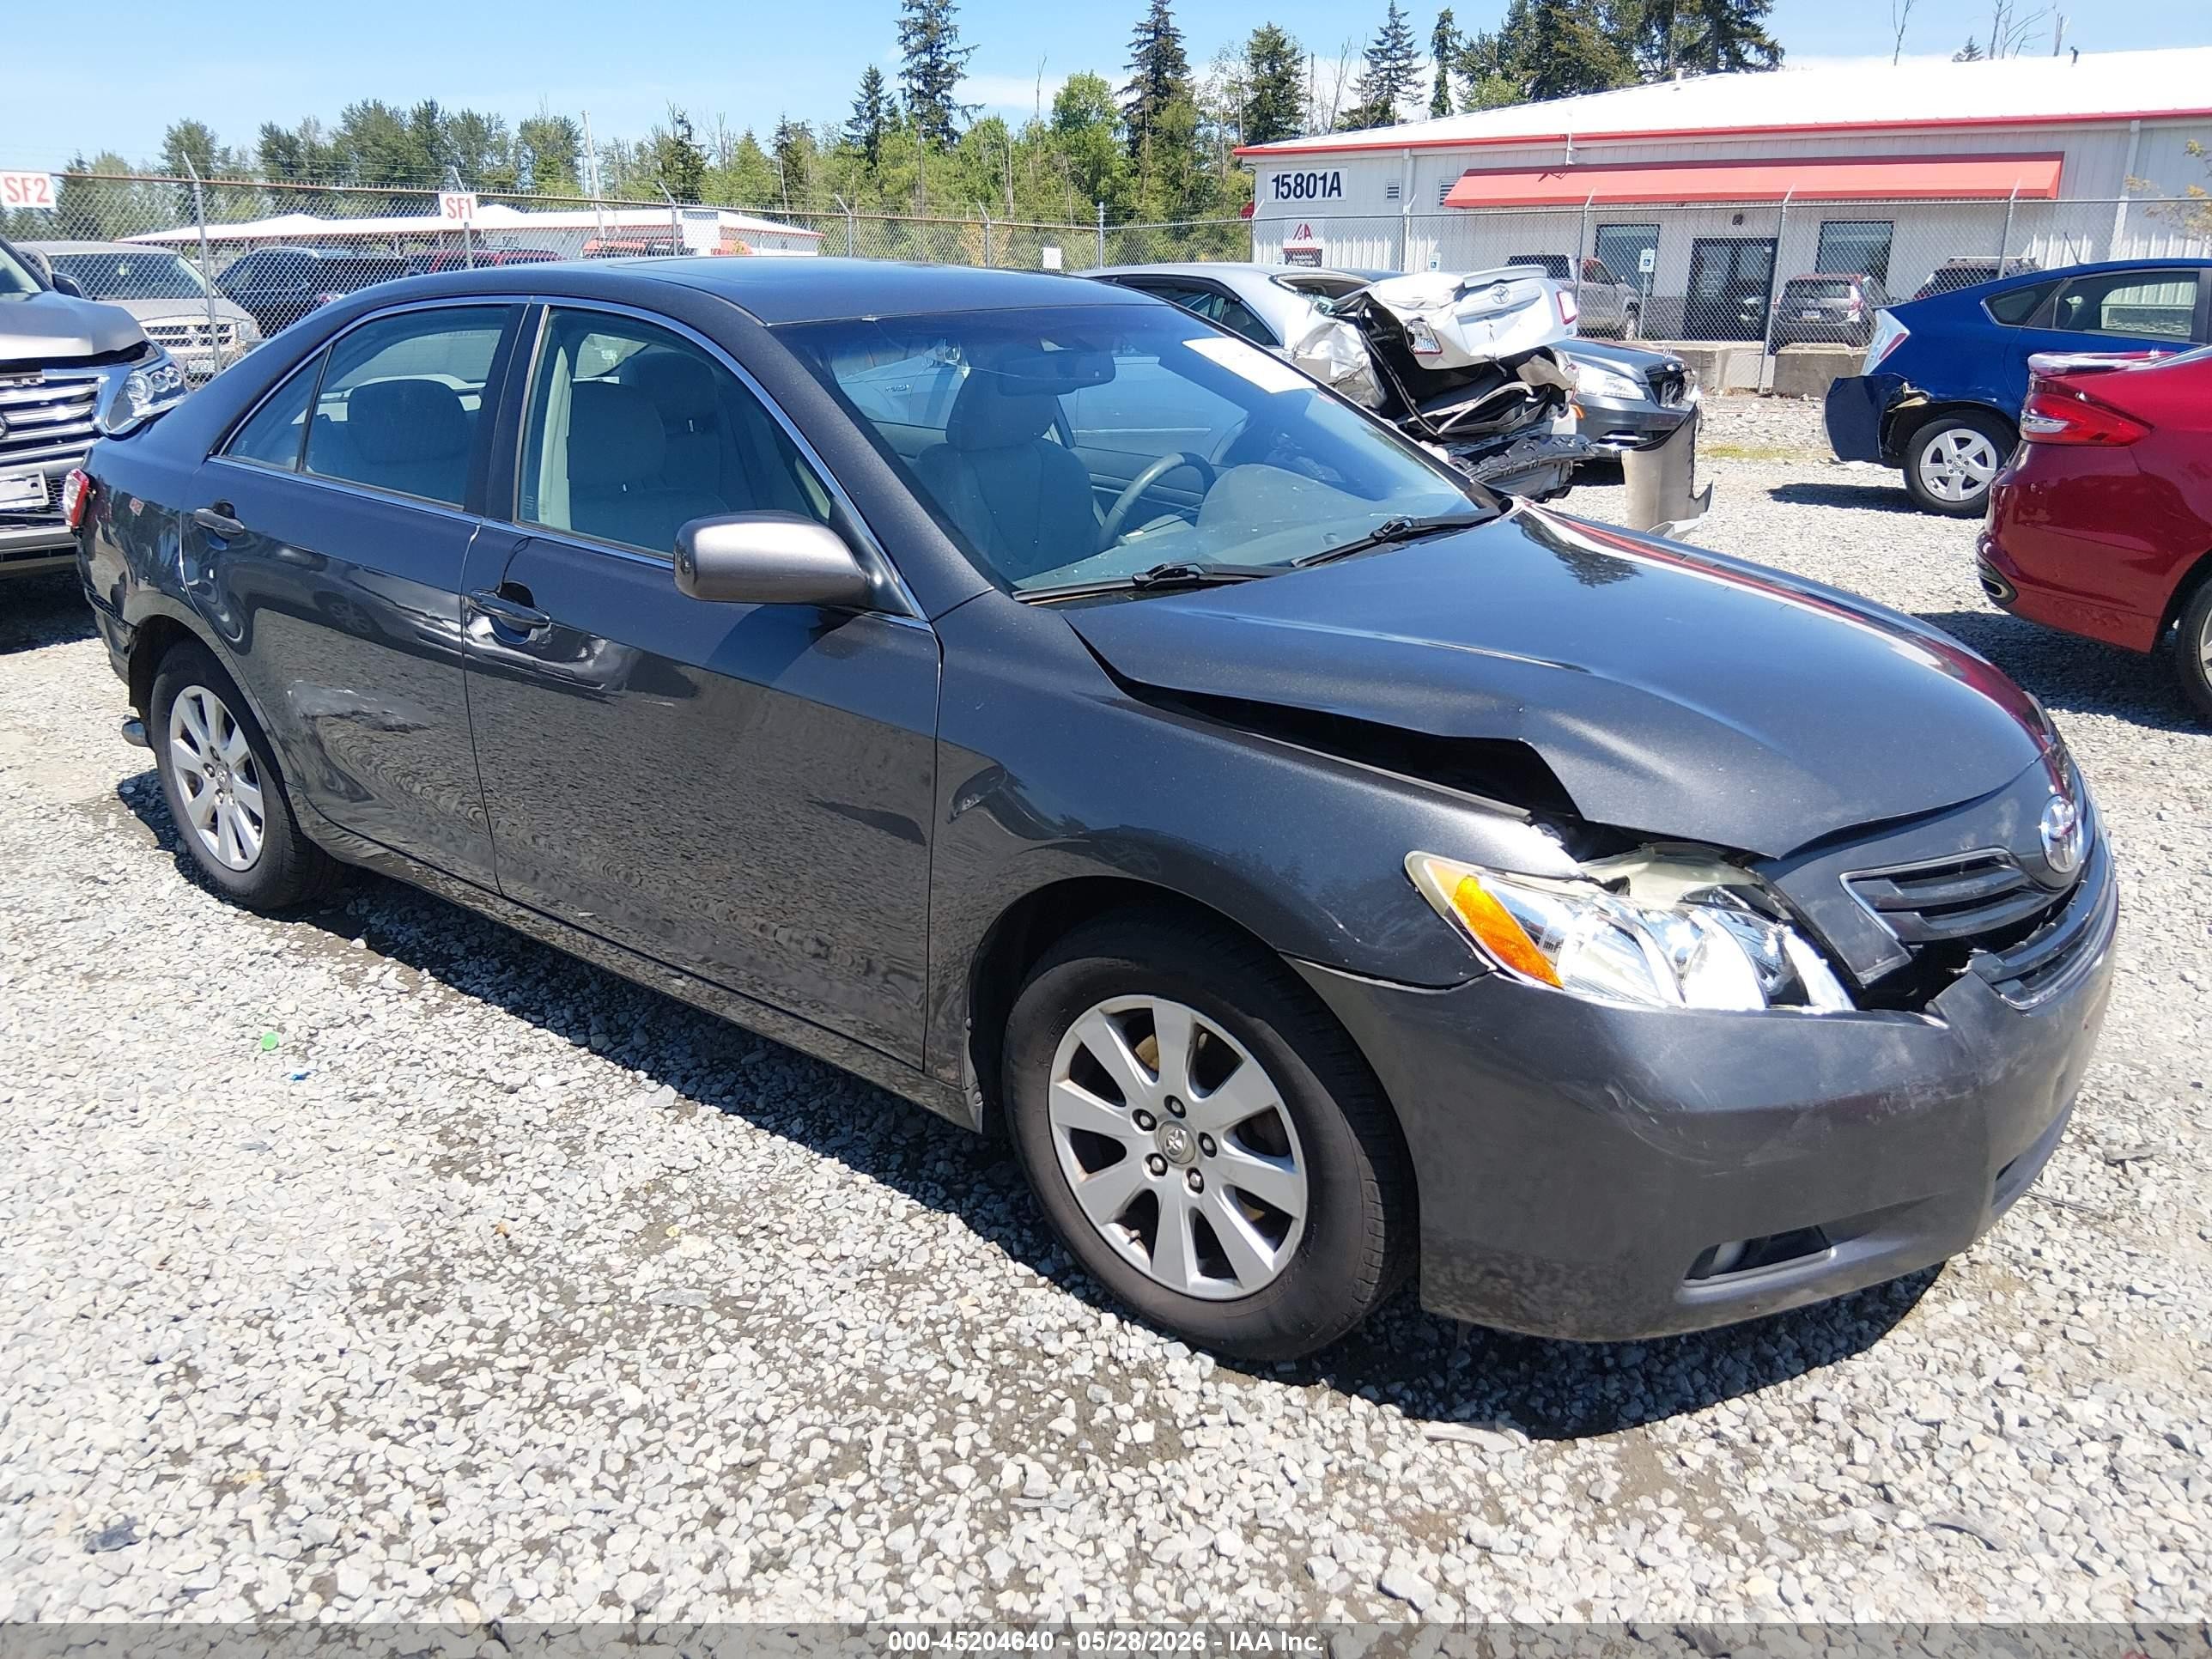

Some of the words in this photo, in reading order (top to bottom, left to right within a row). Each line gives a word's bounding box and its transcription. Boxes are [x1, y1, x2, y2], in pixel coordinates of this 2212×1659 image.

[3, 176, 51, 203] SF2
[1271, 172, 1342, 199] 15801A
[446, 197, 473, 220] SF1
